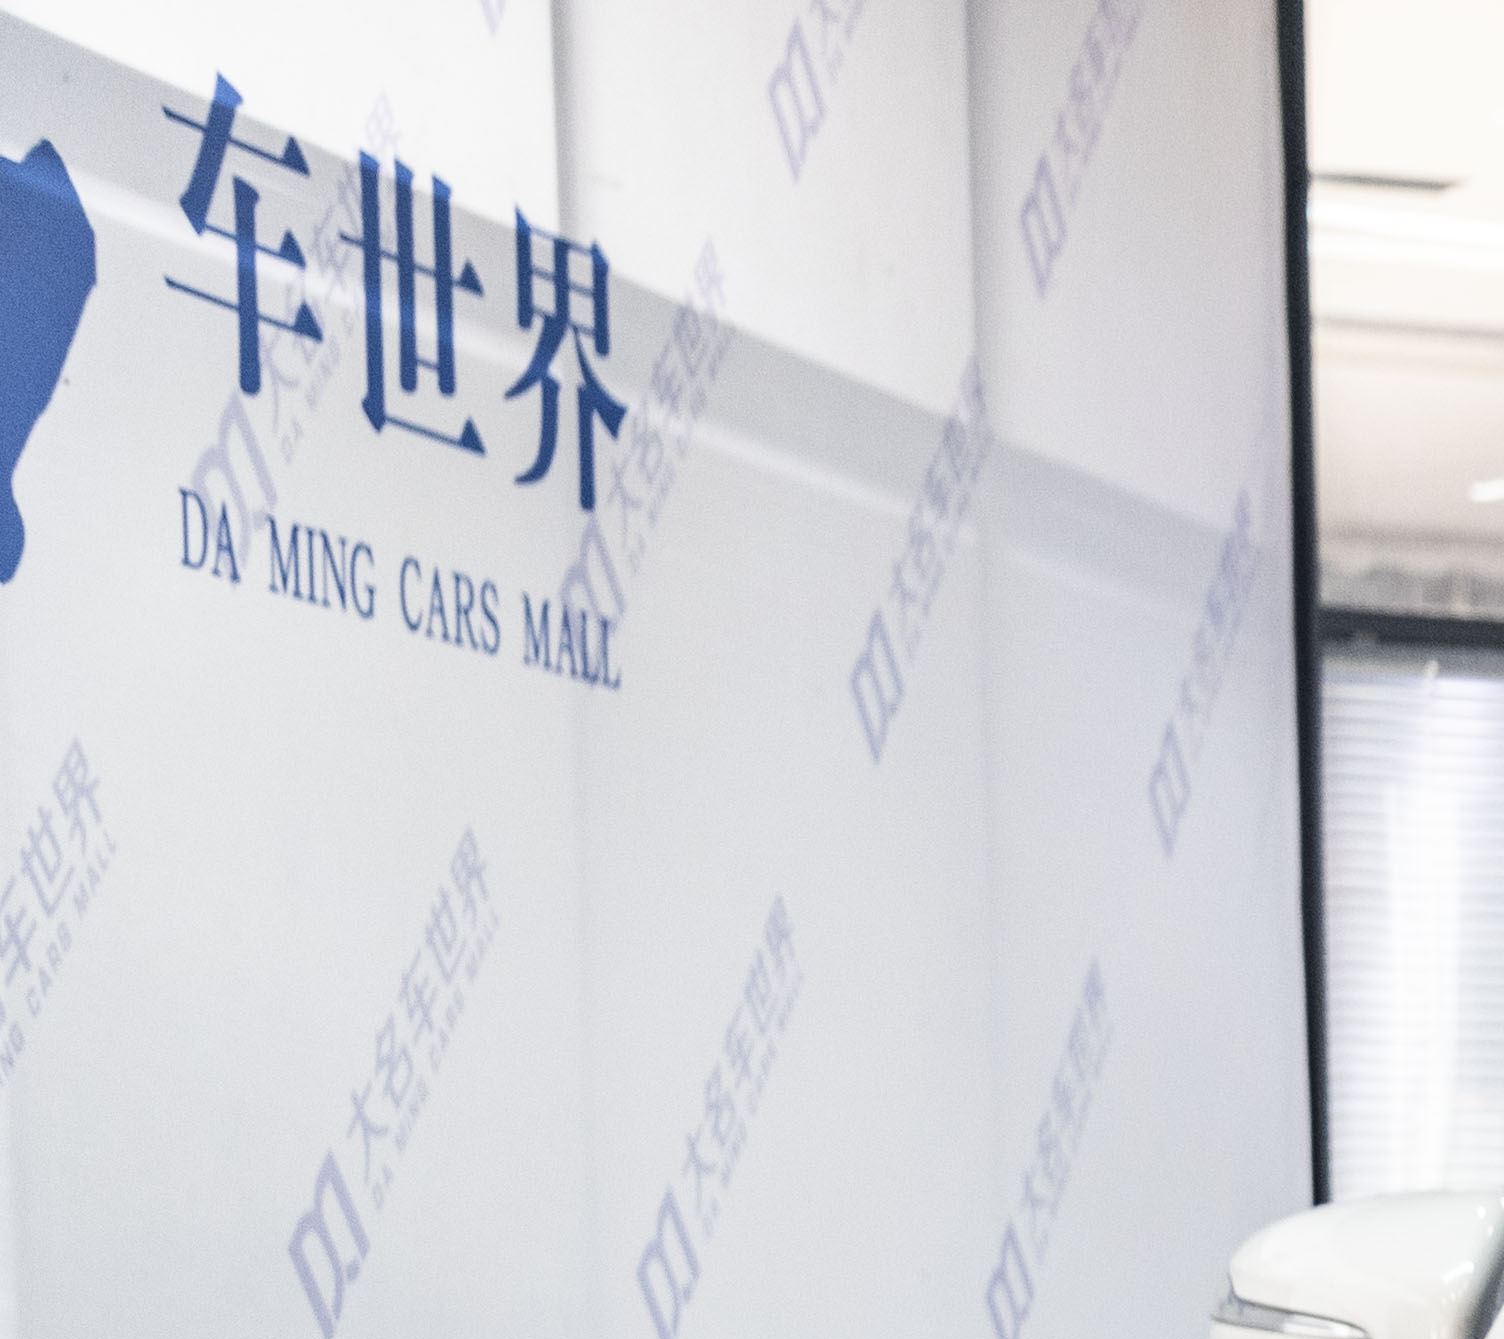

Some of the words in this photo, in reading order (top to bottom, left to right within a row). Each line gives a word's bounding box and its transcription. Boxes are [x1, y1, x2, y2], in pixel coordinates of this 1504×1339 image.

[161, 70, 628, 515] 车世界
[178, 485, 242, 586] DA
[265, 513, 376, 621] MING
[398, 555, 501, 656] CARS
[521, 591, 622, 691] MALL
[346, 825, 489, 1186] 大名车世界
